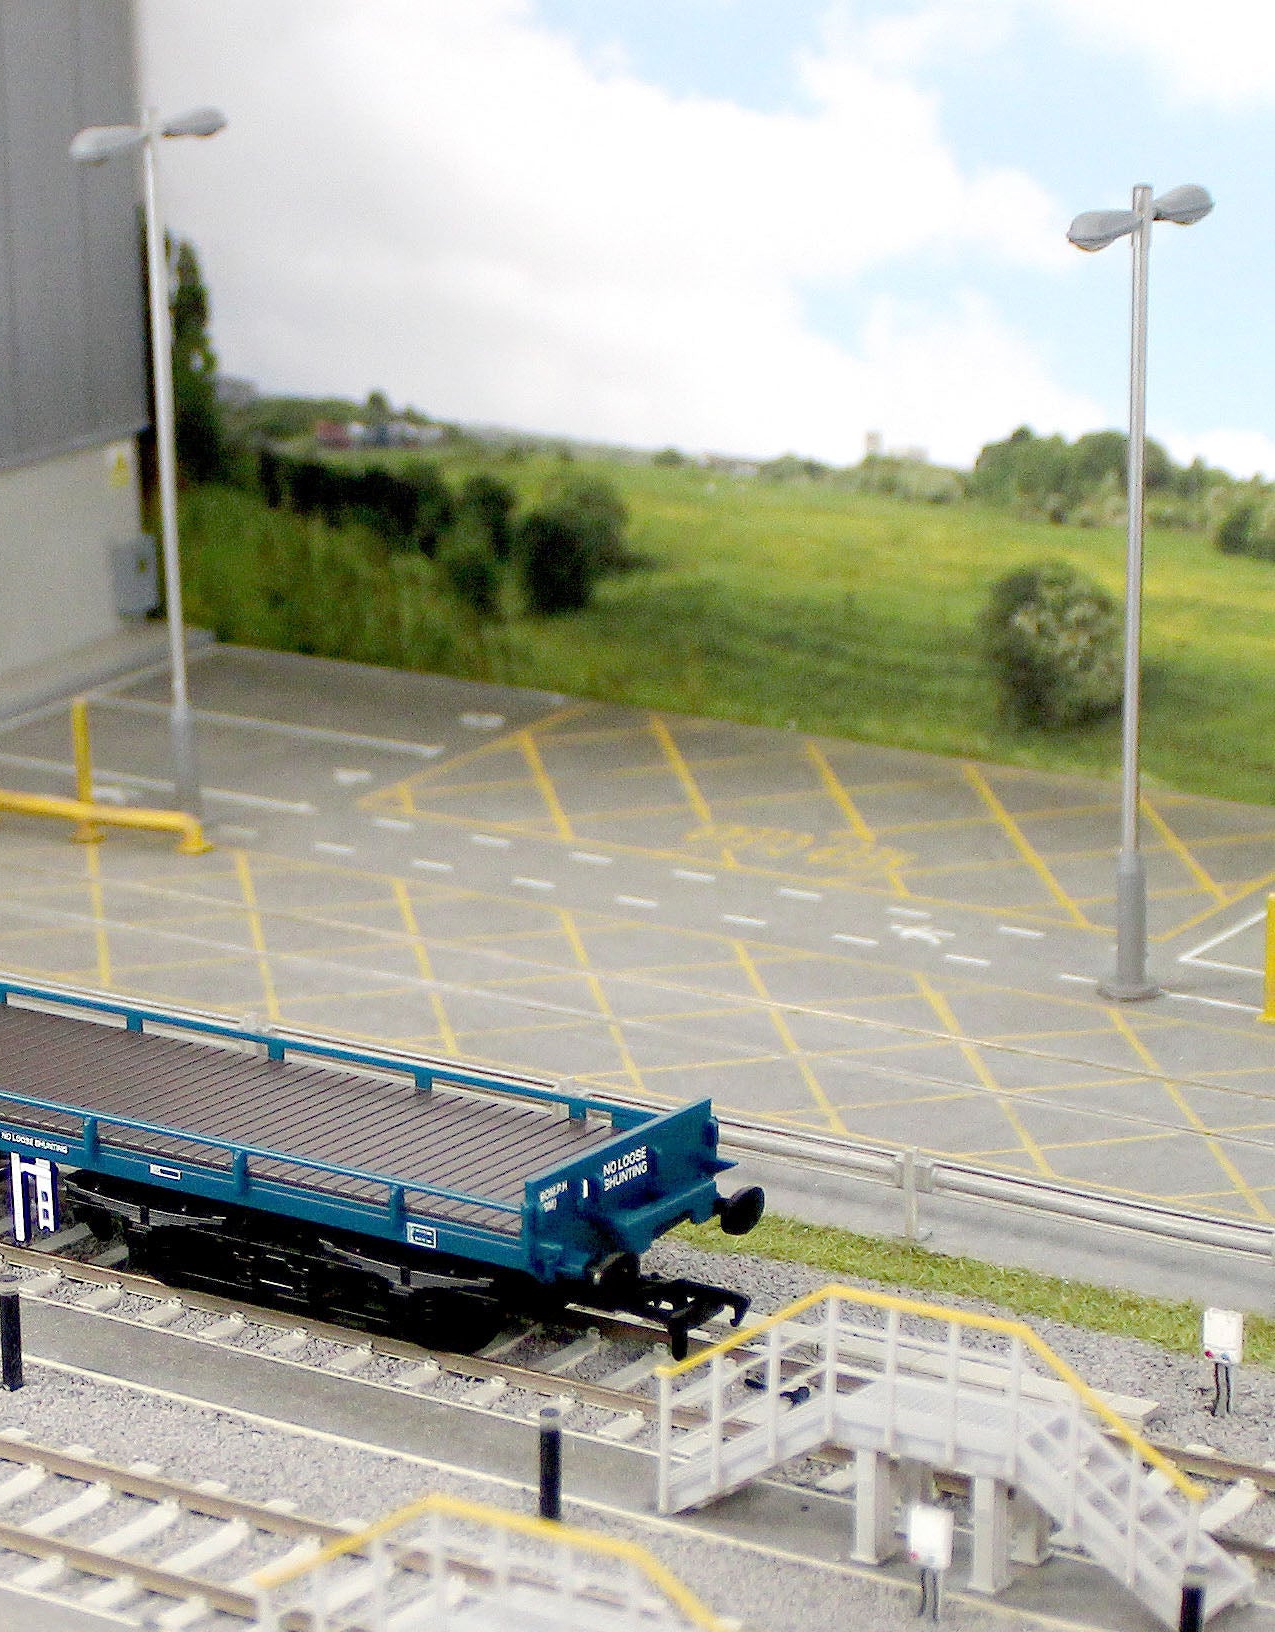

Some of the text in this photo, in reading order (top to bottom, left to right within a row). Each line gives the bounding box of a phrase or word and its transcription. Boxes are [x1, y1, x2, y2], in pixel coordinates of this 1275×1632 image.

[603, 1145, 647, 1177] NO LOOSE
[603, 1160, 648, 1192] SHUNTING
